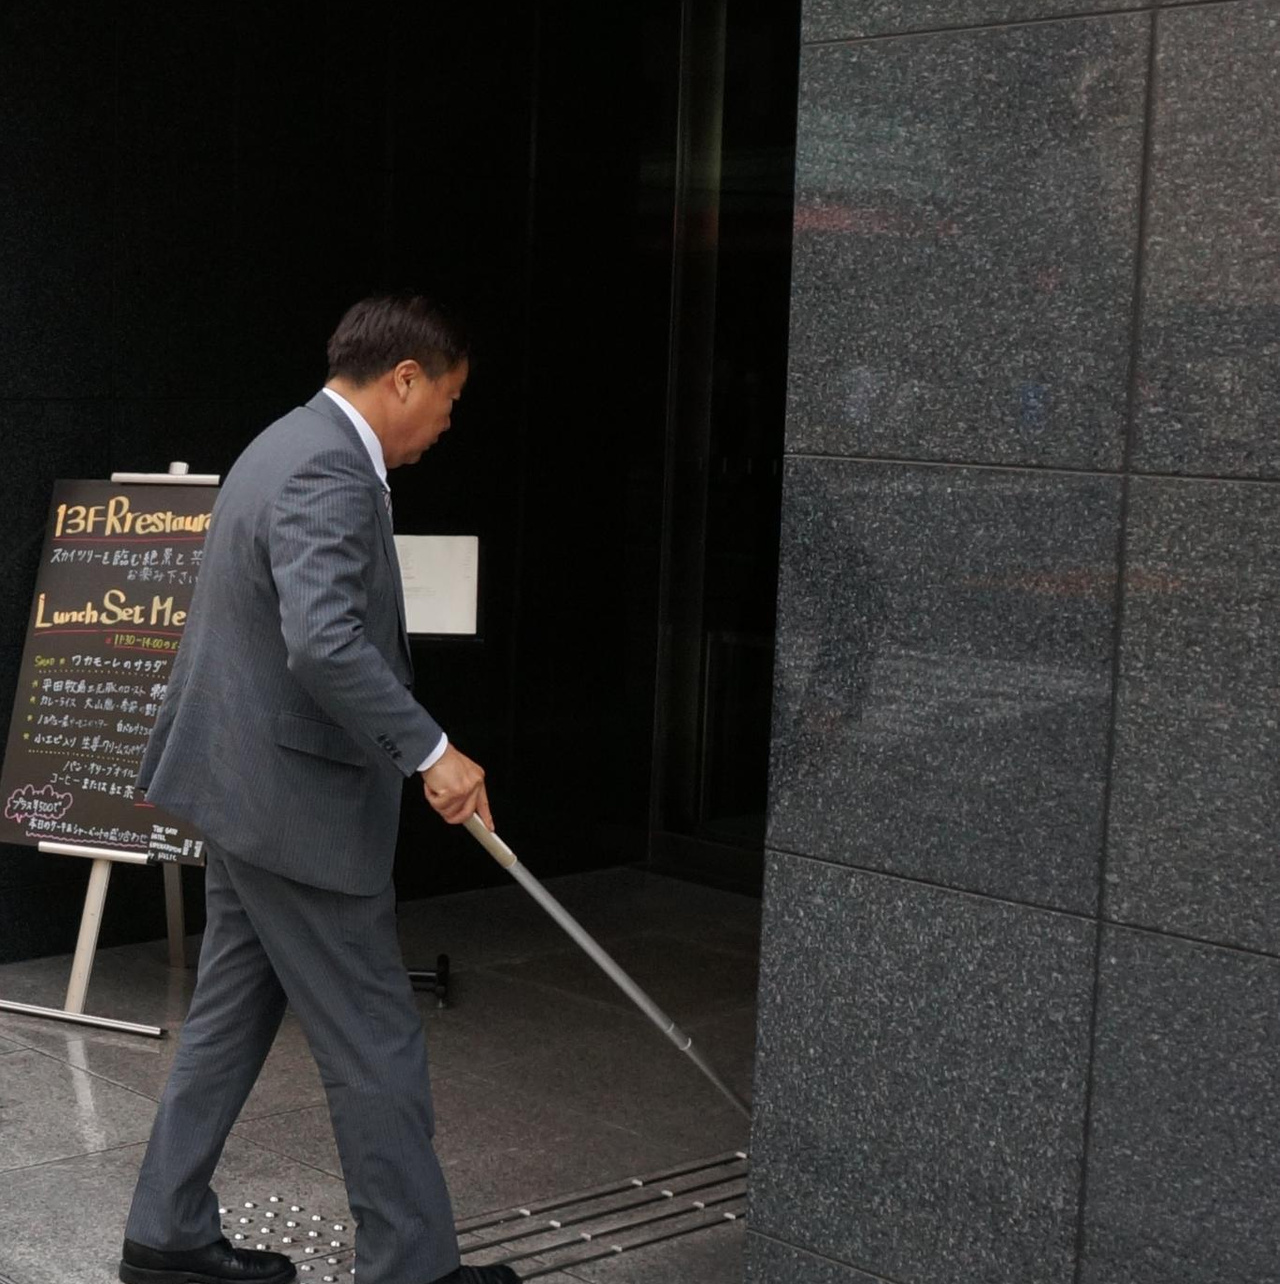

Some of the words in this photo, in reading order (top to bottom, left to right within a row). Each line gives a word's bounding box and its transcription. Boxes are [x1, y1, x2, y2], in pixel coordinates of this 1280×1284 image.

[34, 592, 99, 628] Lunch
[100, 589, 146, 625] Set
[150, 595, 187, 627] Me
